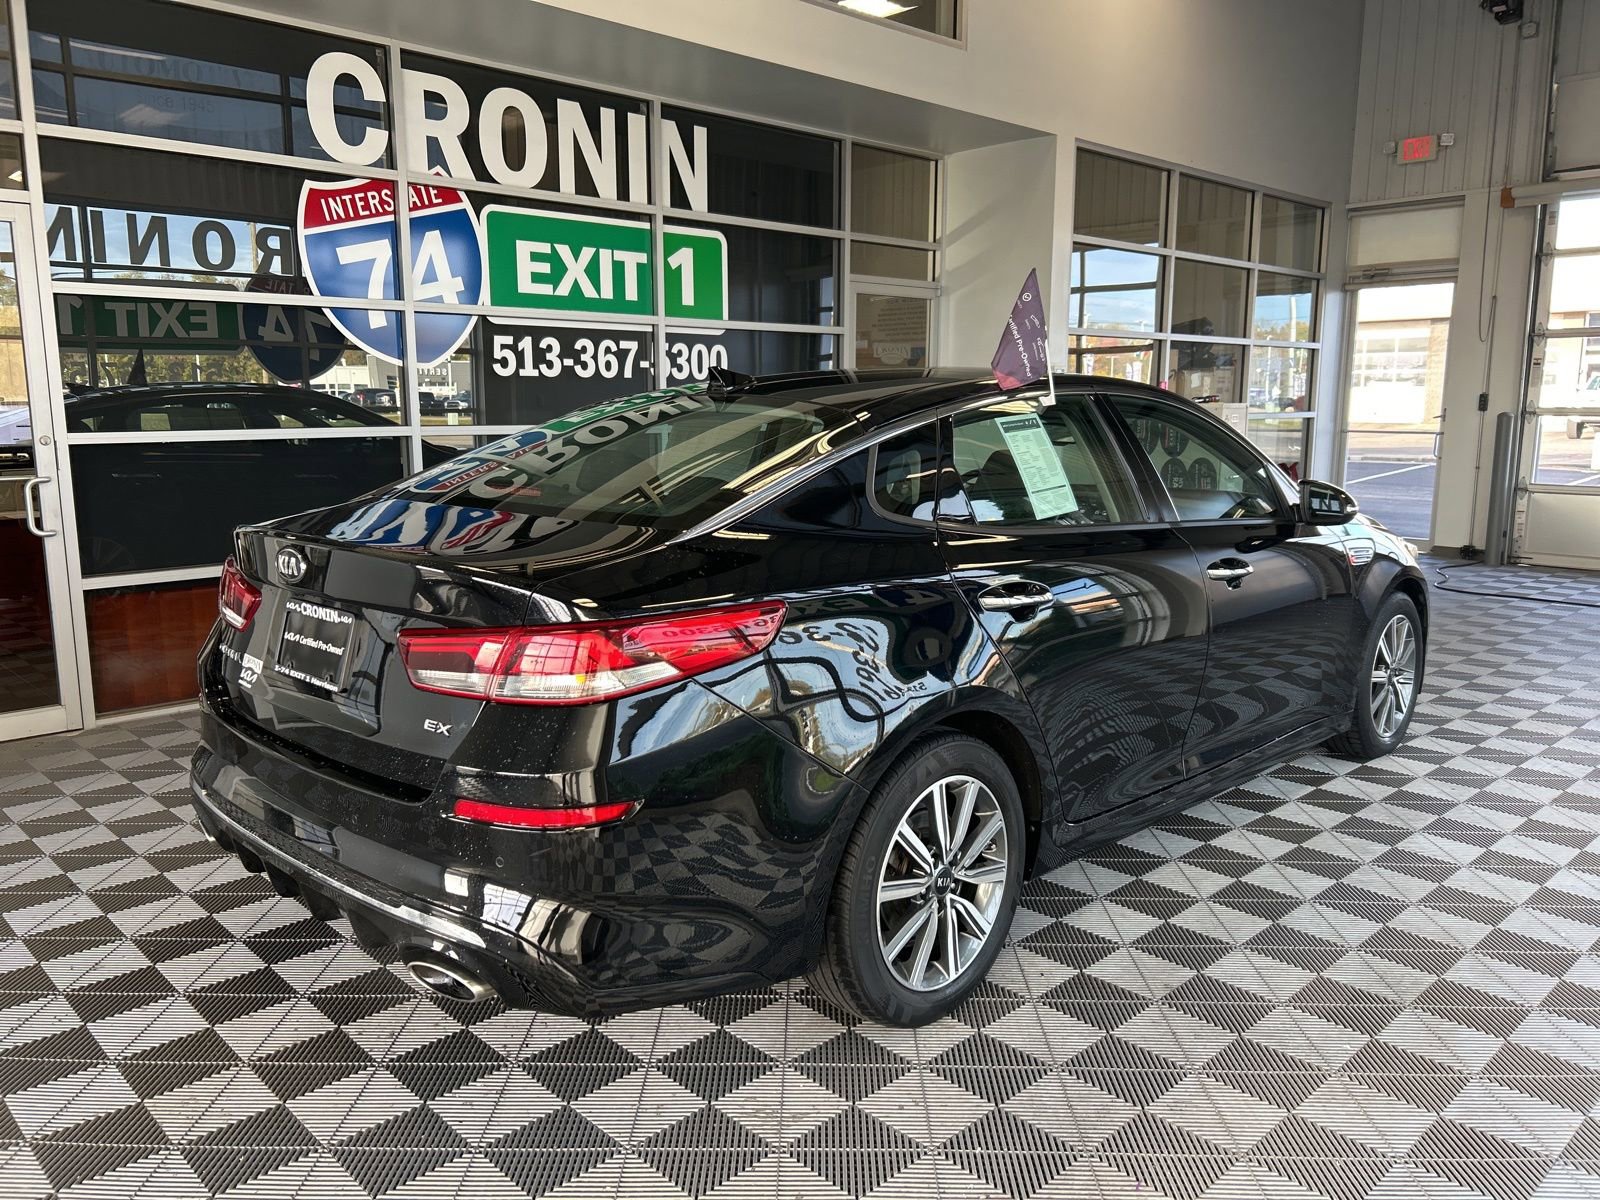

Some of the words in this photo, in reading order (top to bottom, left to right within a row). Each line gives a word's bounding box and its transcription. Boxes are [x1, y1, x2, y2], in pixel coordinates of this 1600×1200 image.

[306, 51, 708, 213] CRONIN
[320, 185, 443, 222] INTERSATE
[336, 230, 464, 330] 74
[515, 239, 648, 302] EXIT
[666, 247, 695, 307] 1
[278, 554, 299, 576] KIA
[301, 602, 339, 623] CRONIN
[300, 635, 318, 648] Certified
[274, 664, 290, 675] I-74
[289, 670, 305, 680] EXIT
[310, 677, 338, 692] Harrison
[424, 718, 453, 737] EX
